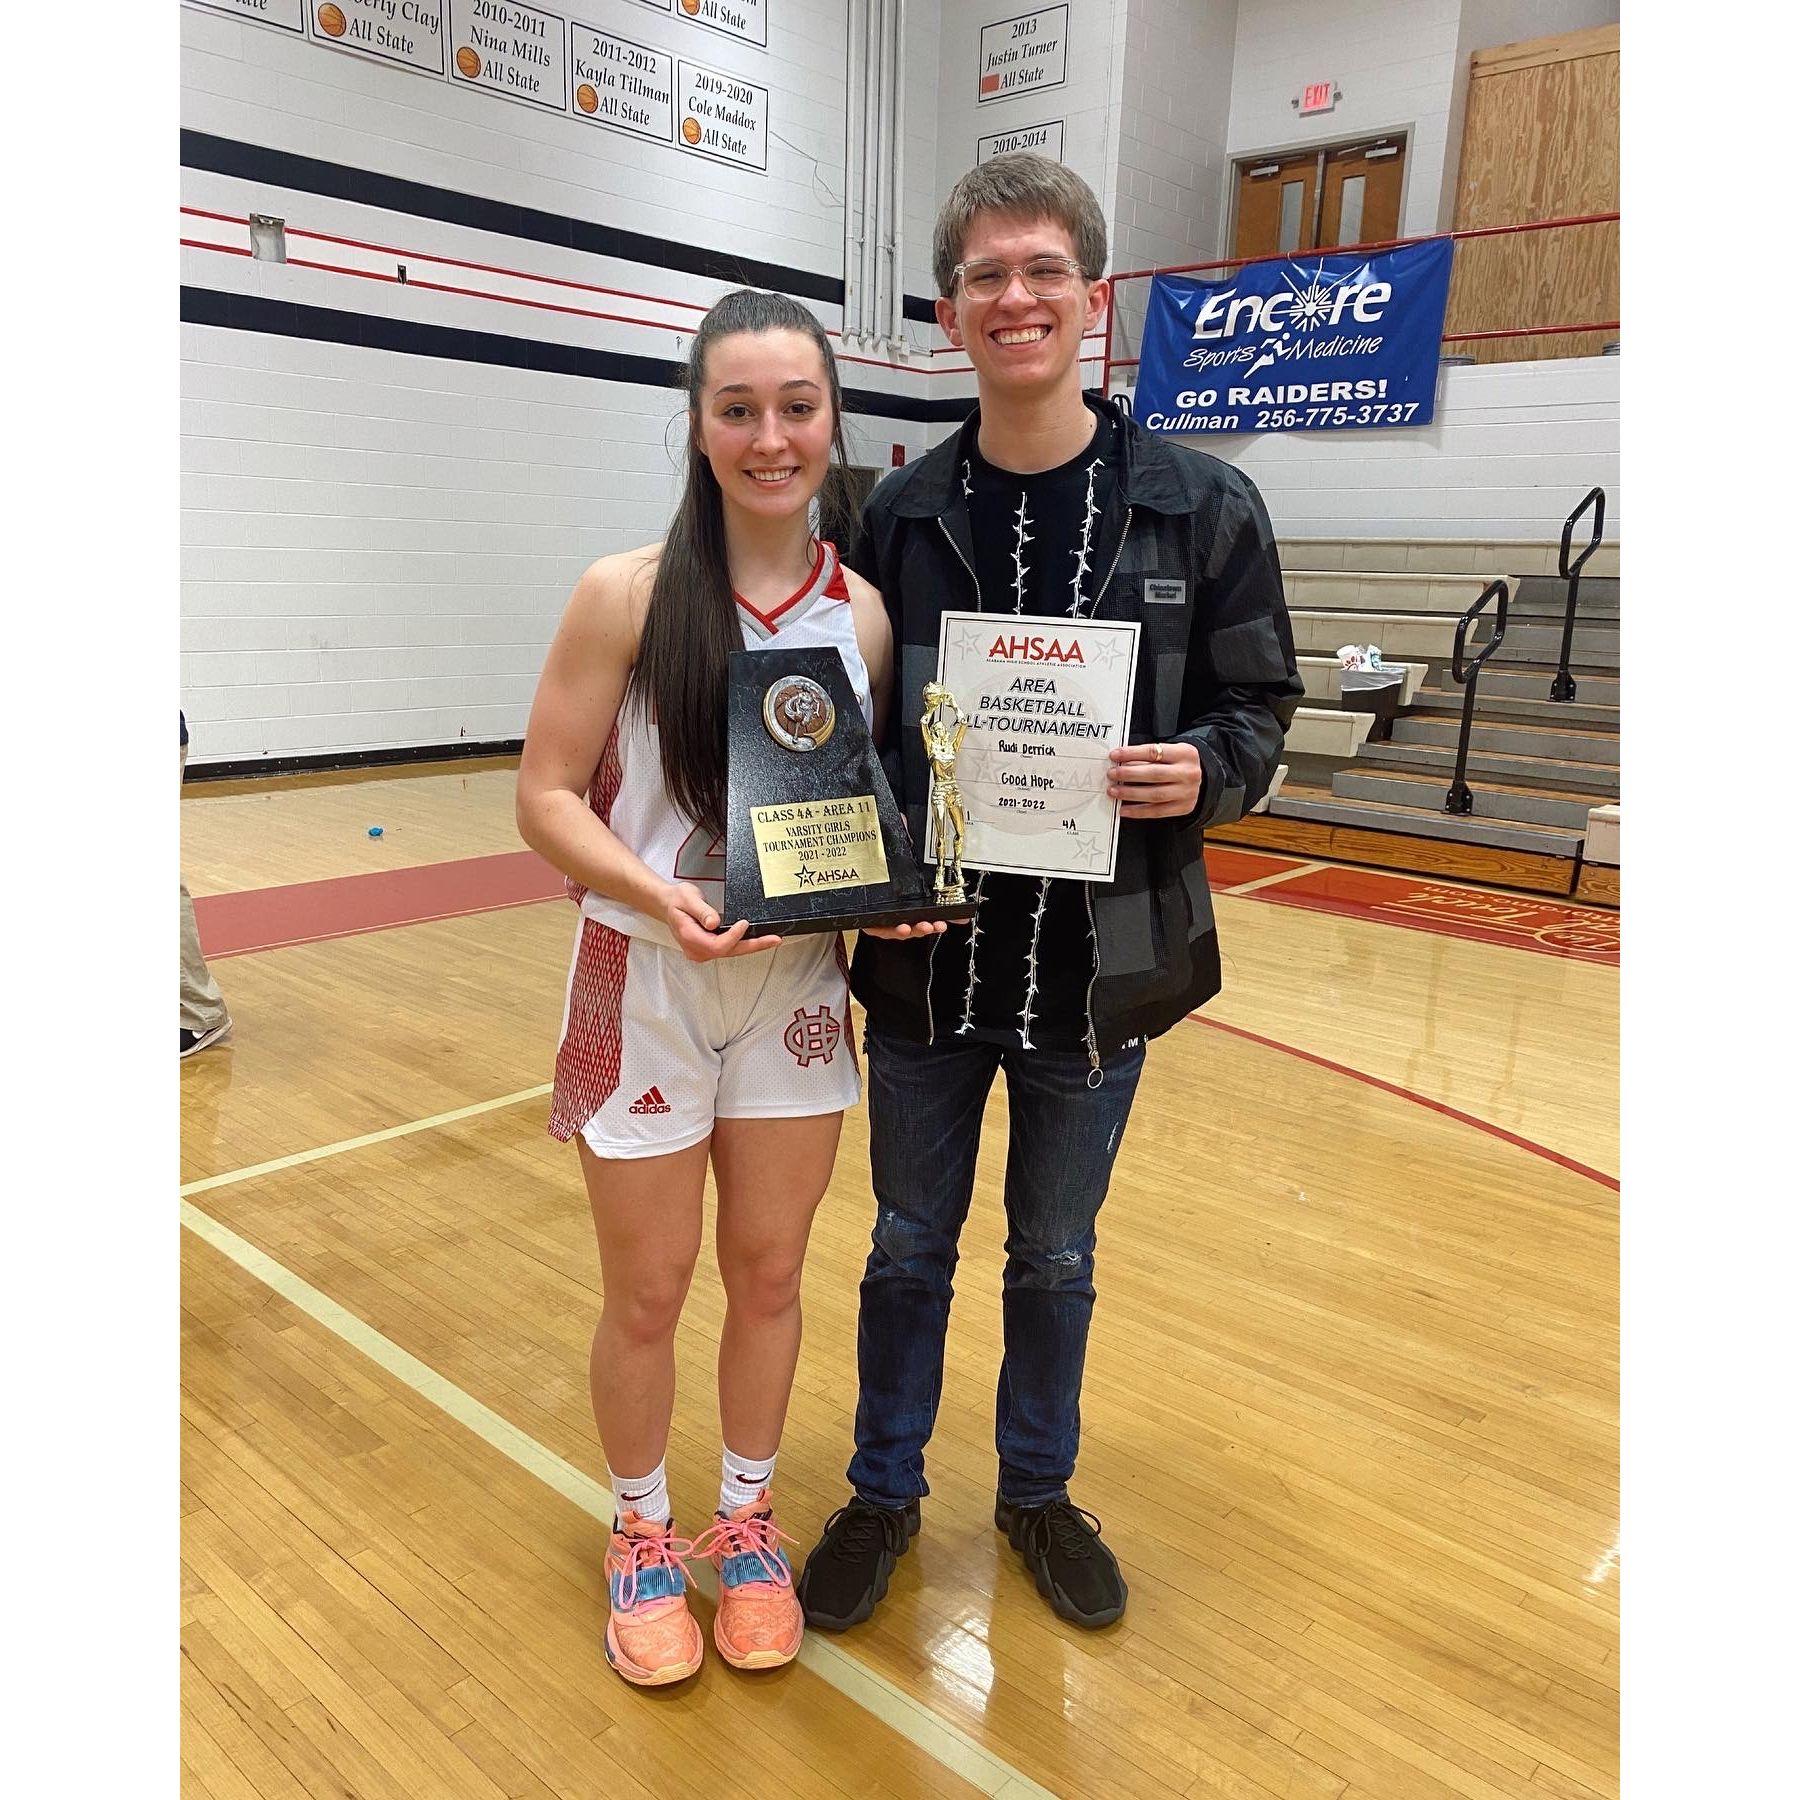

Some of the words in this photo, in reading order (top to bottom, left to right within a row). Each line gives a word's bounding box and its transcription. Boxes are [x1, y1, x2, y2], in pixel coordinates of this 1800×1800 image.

[402, 1, 440, 35] Clay
[473, 0, 546, 38] 2010-2011
[701, 0, 718, 20] All
[720, 6, 747, 31] State
[1011, 18, 1038, 39] 2013
[349, 18, 373, 42] All
[377, 25, 414, 54] State
[470, 25, 507, 54] Nina
[511, 38, 551, 67] Mills
[592, 37, 657, 75] 2011-2012
[986, 48, 1019, 72] Justin
[1021, 39, 1059, 60] Turner
[483, 60, 504, 82] All
[507, 66, 540, 93] State
[575, 58, 616, 88] Kayla
[620, 72, 670, 105] Tillman
[695, 72, 754, 106] 2019-2020
[1000, 71, 1016, 90] All
[1018, 66, 1045, 87] State
[1305, 83, 1331, 108] EXIT
[600, 96, 619, 117] All
[620, 101, 650, 126] State
[688, 95, 713, 117] Cole
[714, 103, 757, 131] Maddox
[702, 128, 720, 147] All
[721, 133, 748, 156] State
[992, 129, 1048, 155] 2010-2014
[1183, 346, 1255, 373] Sports
[1285, 335, 1384, 362] Medicine
[1176, 389, 1217, 409] GO
[1227, 378, 1388, 406] RAIDERS!
[1146, 412, 1240, 431] Cullman
[1254, 402, 1421, 430] 256-775-3737
[988, 635, 1085, 664] AHSAA
[1009, 677, 1057, 694] AREA
[979, 696, 1086, 717] BASKETBALL
[998, 739, 1018, 753] Rudi
[1022, 743, 1056, 756] Derrick
[1001, 772, 1027, 787] Good
[1031, 774, 1055, 791] Hope
[757, 808, 795, 824] CLASS
[797, 807, 814, 820] 4A
[823, 802, 856, 817] AREA
[859, 801, 871, 814] 11
[998, 797, 1046, 810] 2021-2022
[786, 823, 823, 838] VARSITY
[824, 820, 851, 834] GIRLS
[1062, 818, 1077, 831] 4A
[763, 836, 825, 853] TOURNAMENT
[826, 830, 877, 846] CHAMPIONS
[798, 851, 819, 862] 2021
[826, 846, 848, 858] 2022
[817, 868, 859, 882] AHSAA
[628, 1103, 672, 1115] adidas
